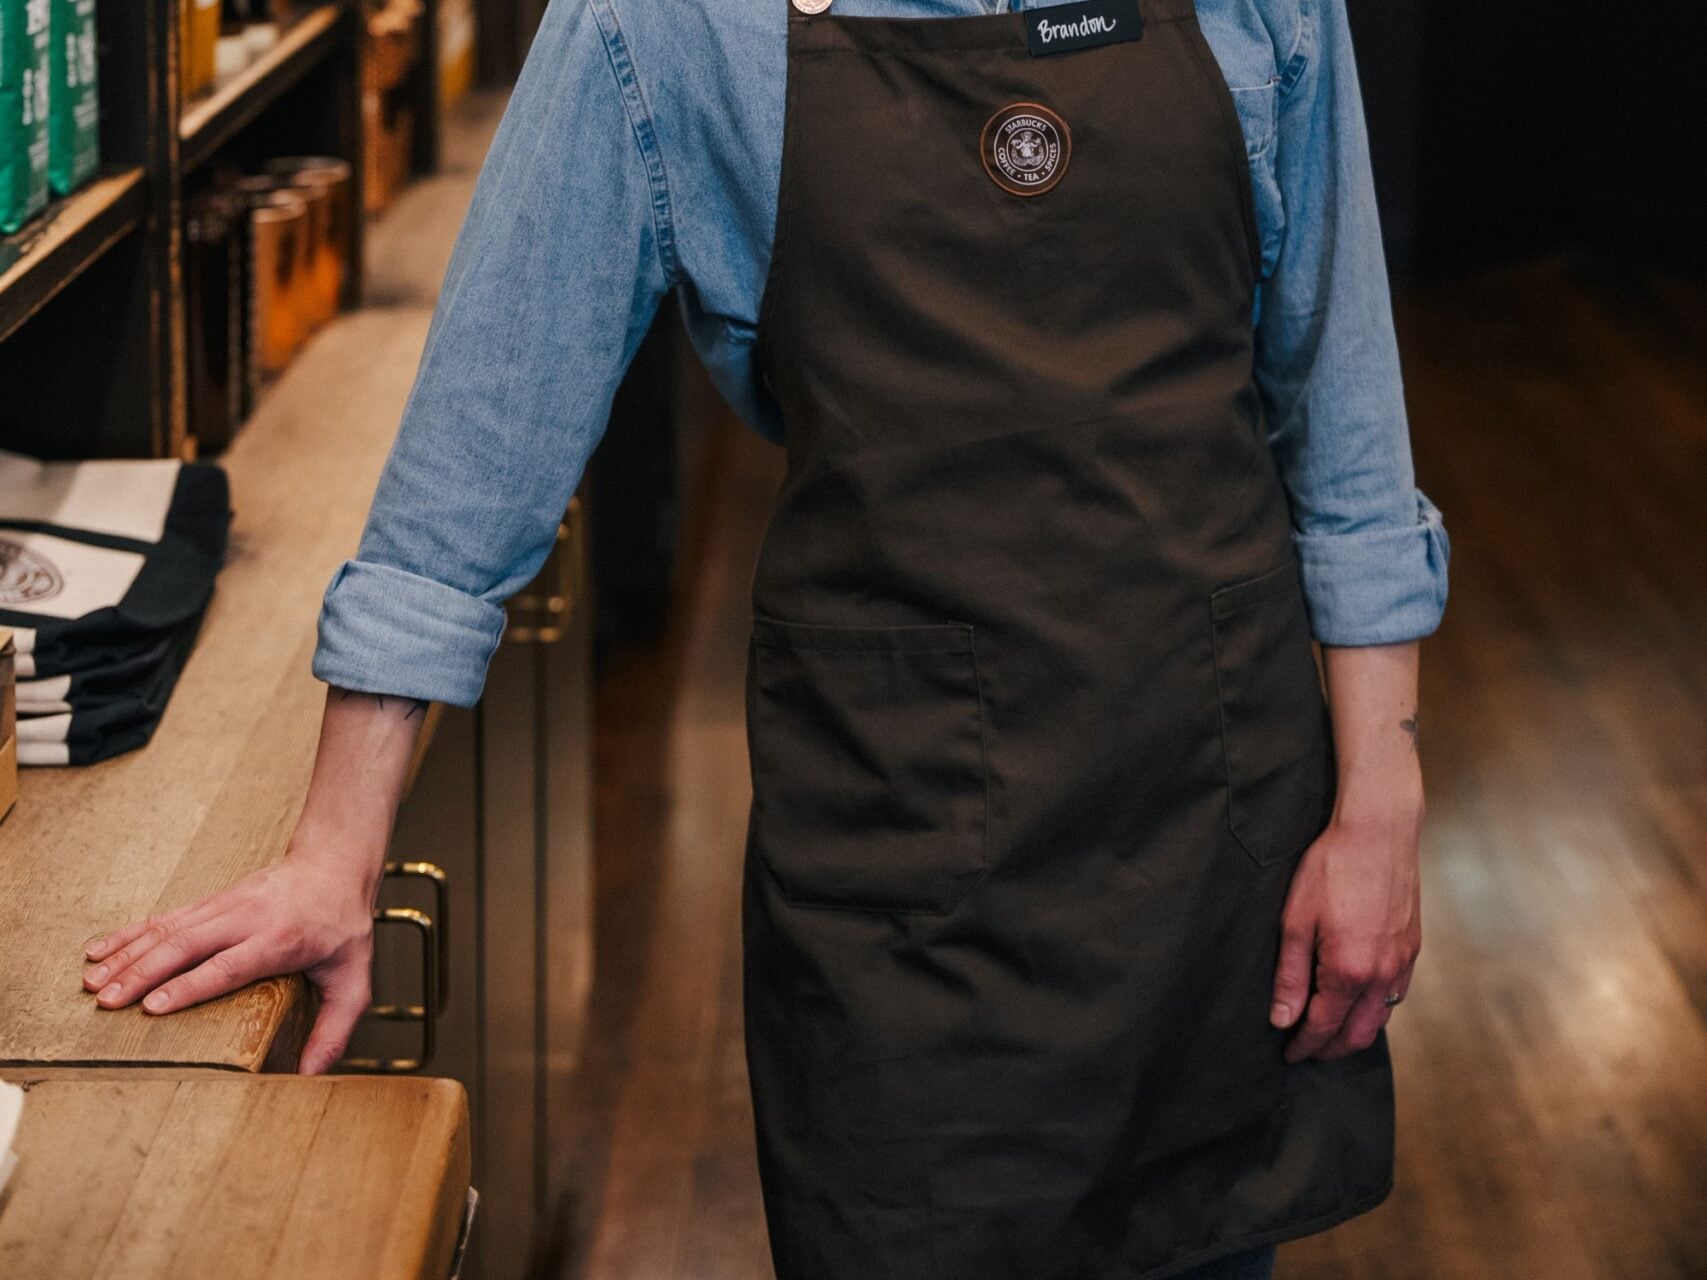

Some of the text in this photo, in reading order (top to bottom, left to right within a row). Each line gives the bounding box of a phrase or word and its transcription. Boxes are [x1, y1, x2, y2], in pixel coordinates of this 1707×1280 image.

[1037, 14, 1116, 43] Brandon
[1004, 118, 1047, 134] STARBUCKS
[998, 143, 1057, 181] COFFEE TEA SPICES
